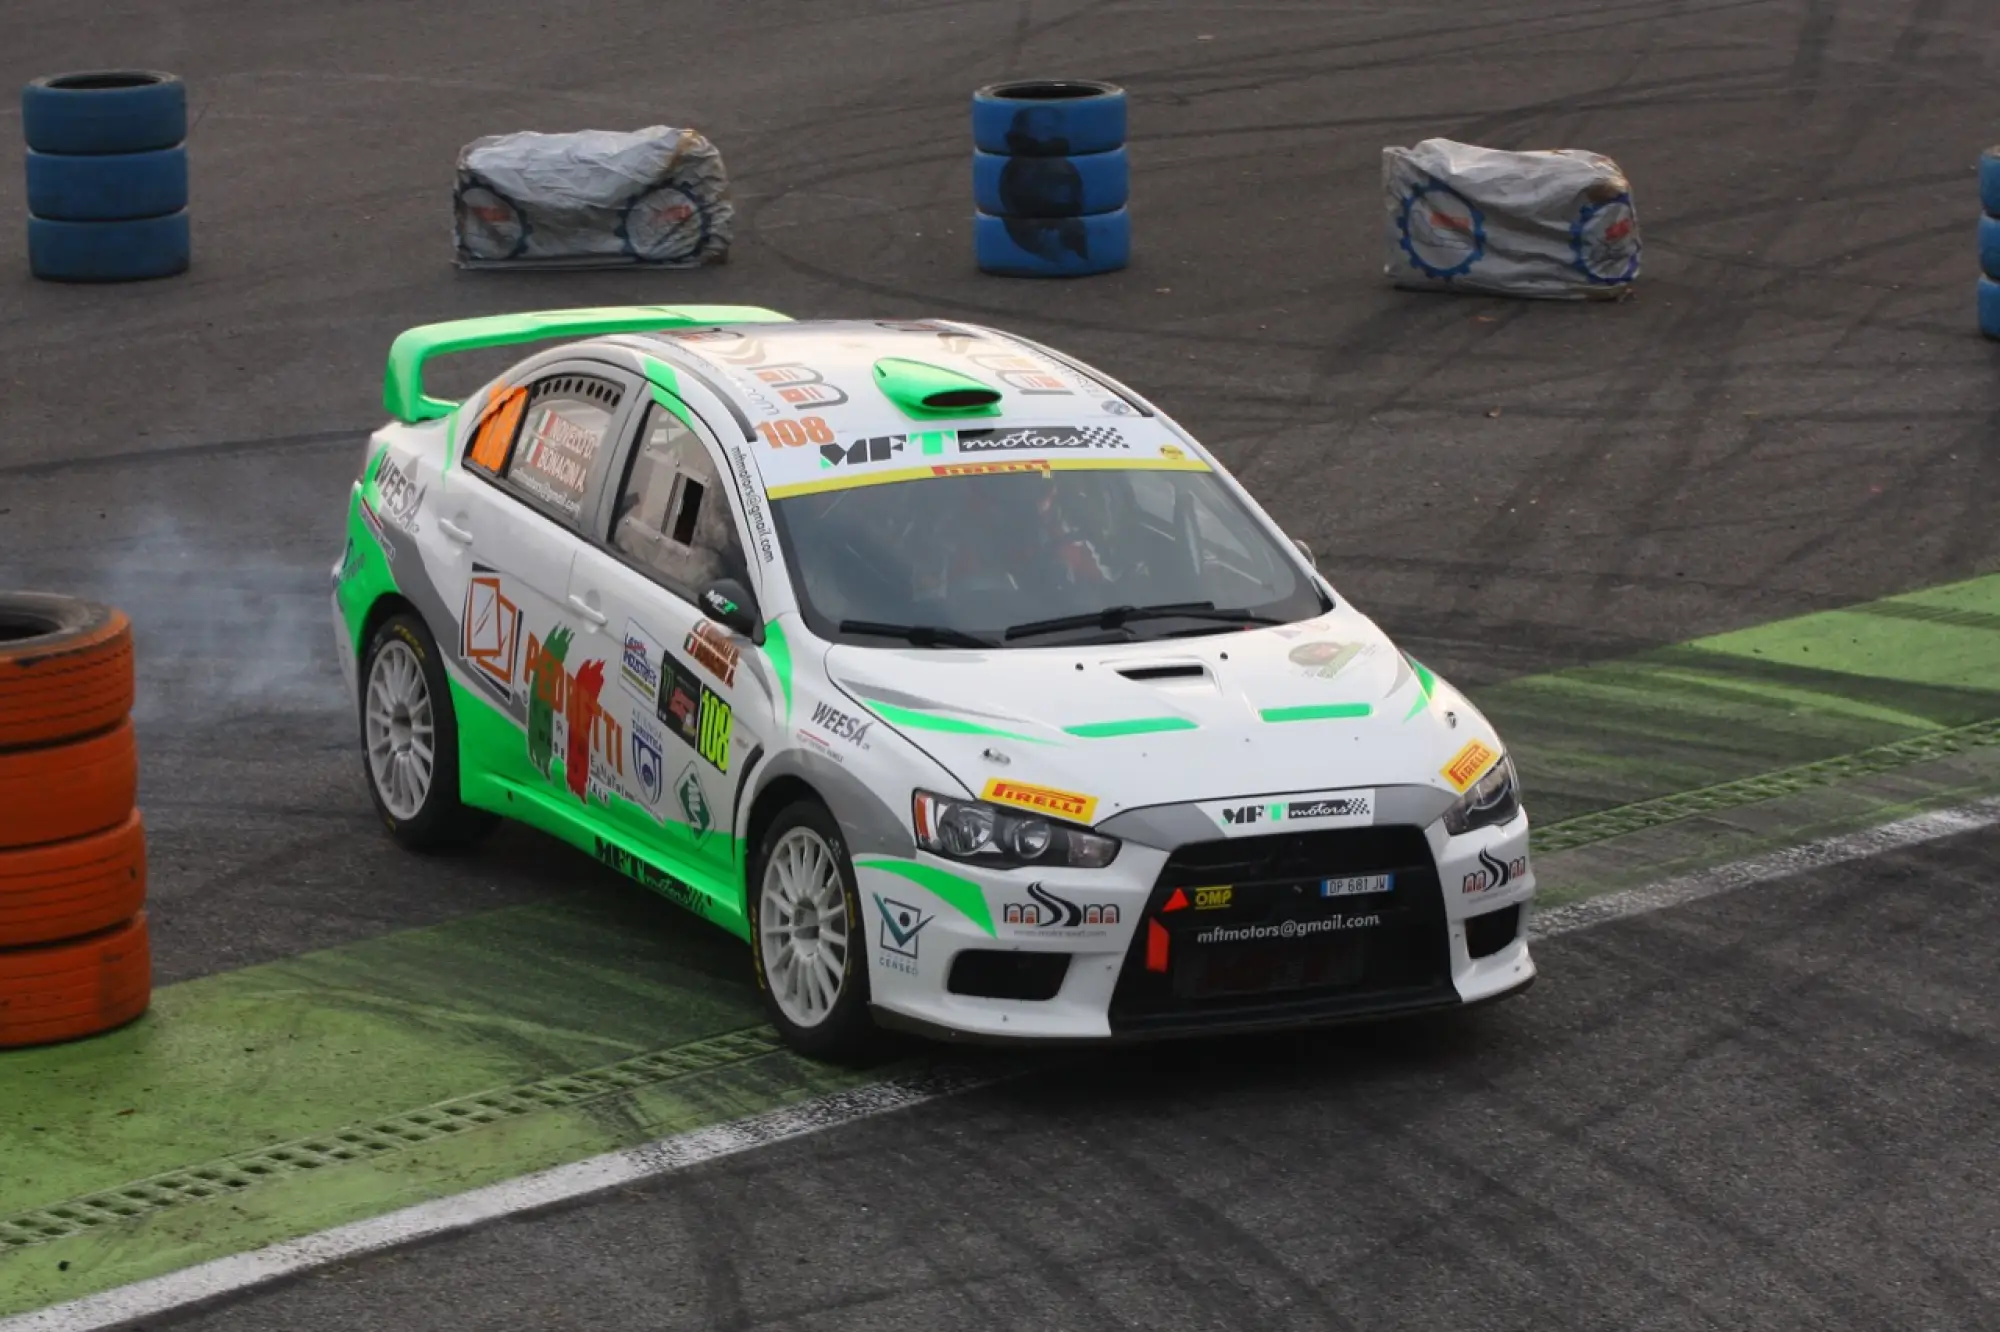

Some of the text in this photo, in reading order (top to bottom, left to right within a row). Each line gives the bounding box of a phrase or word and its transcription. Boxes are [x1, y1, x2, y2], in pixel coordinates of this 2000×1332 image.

[755, 415, 835, 450] 108
[820, 429, 1083, 470] MFT motors
[931, 458, 1050, 477] PIRELLI
[731, 445, 775, 563] mftmotors@gmail.com
[700, 687, 732, 772] 108
[811, 701, 875, 747] WEESA
[1448, 744, 1490, 785] PIRELLI
[992, 783, 1087, 815] PIRELLI
[1220, 801, 1350, 826] MFT motors
[1195, 889, 1232, 906] OMP
[1347, 877, 1369, 893] 681
[1197, 914, 1381, 944] mftmotors@gmail.com
